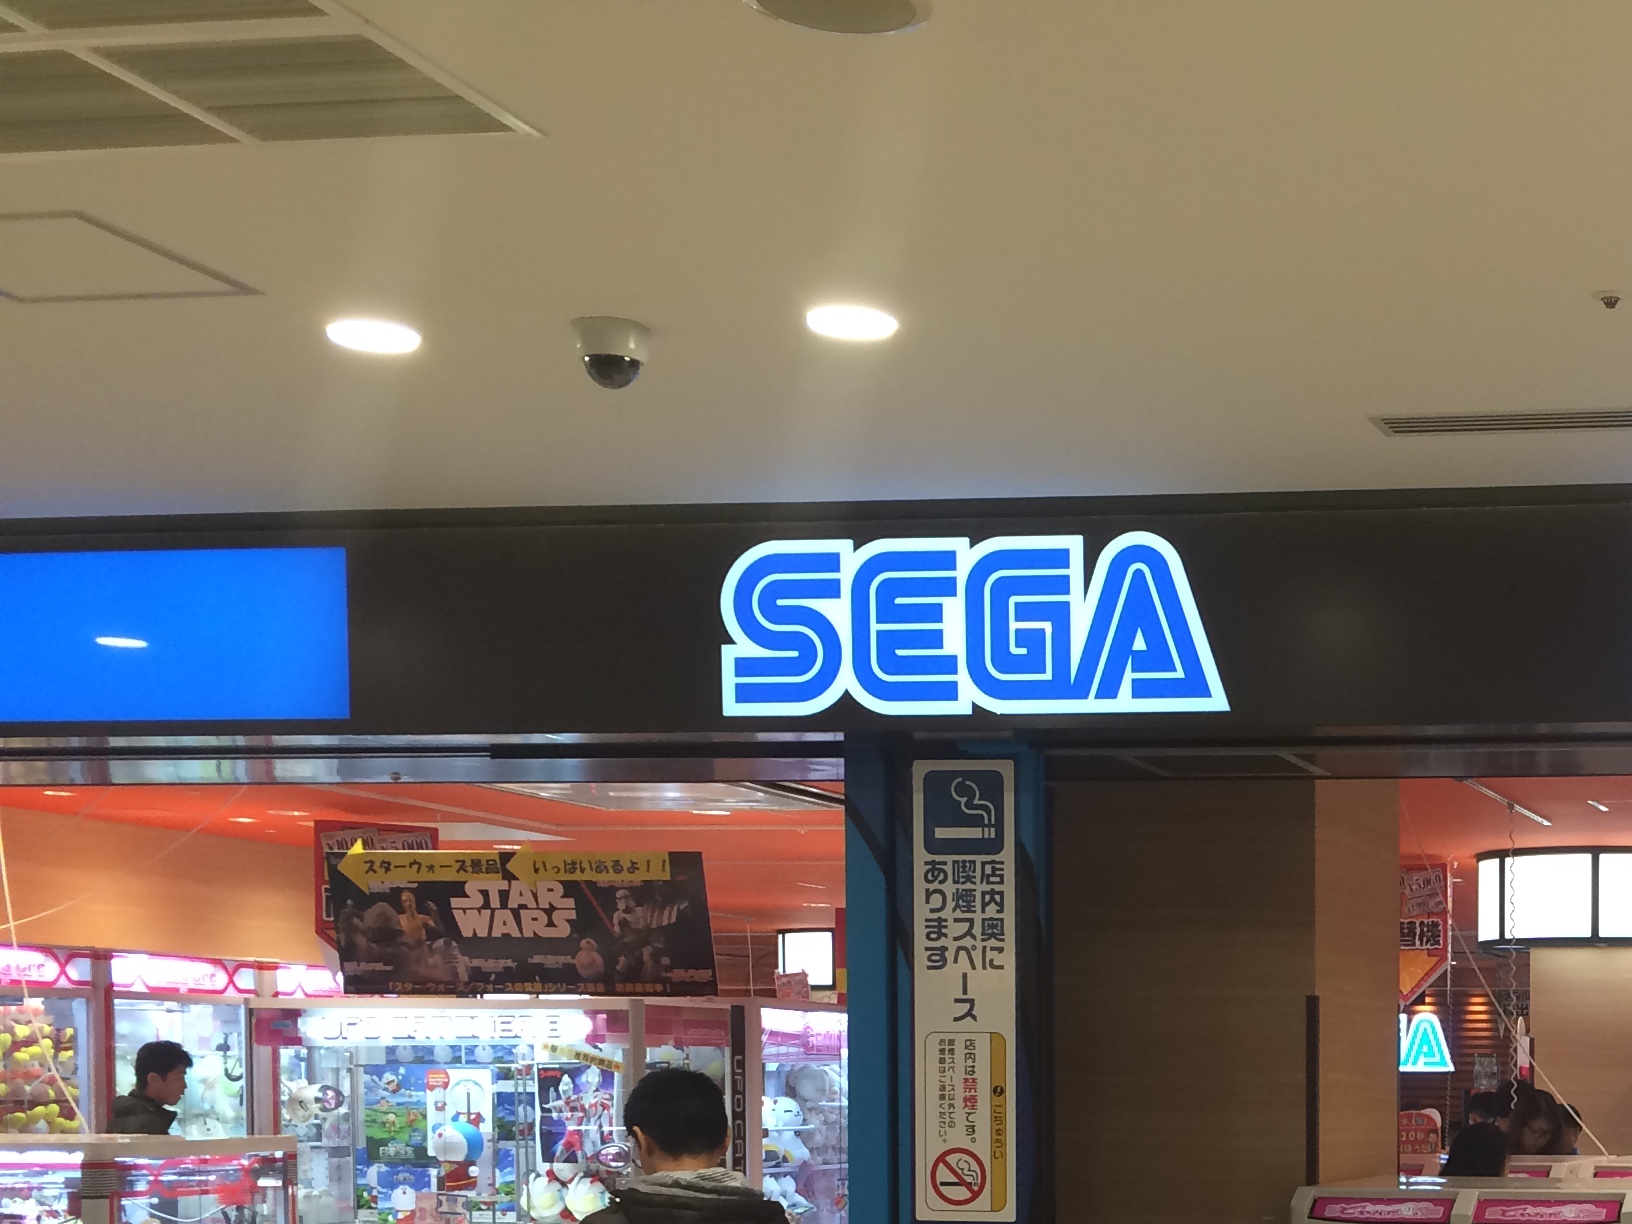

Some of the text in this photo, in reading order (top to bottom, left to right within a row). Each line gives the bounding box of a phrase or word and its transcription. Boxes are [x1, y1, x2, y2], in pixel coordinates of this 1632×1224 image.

[720, 530, 1231, 717] SEGA
[363, 857, 500, 876] スターウォーズ景品
[450, 880, 576, 909] STAR
[924, 860, 949, 970] あります
[980, 859, 1005, 970] 店内奥に
[452, 909, 578, 938] WARS
[952, 859, 978, 1023] 喫煙スペース
[734, 1055, 745, 1112] UFO
[962, 1039, 979, 1144] 店内は禁煙です。
